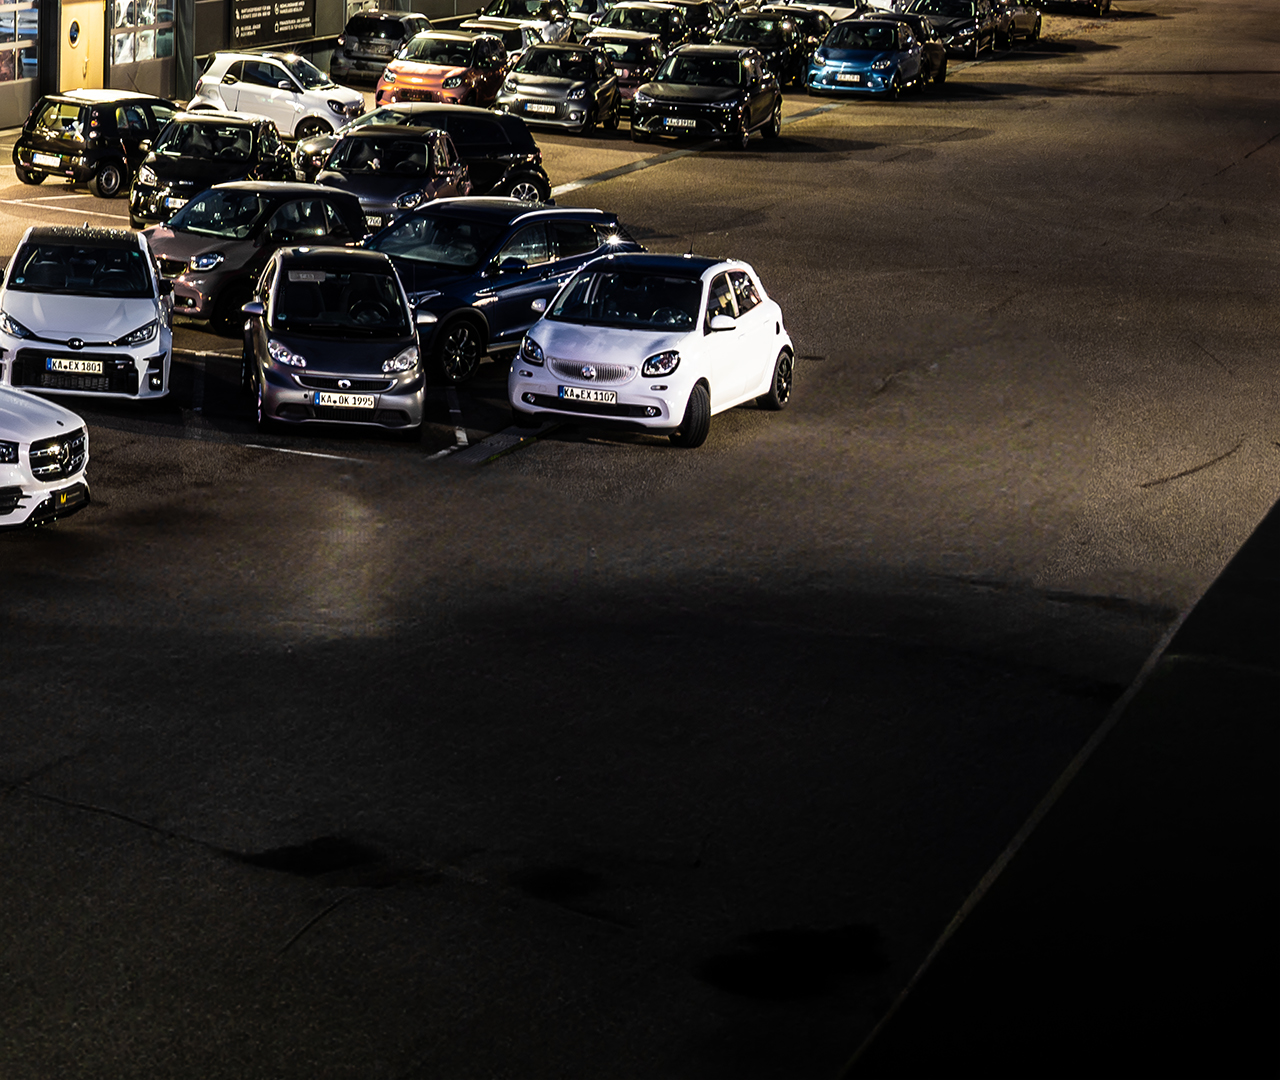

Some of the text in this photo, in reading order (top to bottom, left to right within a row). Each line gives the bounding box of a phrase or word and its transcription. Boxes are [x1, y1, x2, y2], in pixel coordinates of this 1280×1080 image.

[82, 362, 102, 372] 1801
[352, 395, 374, 407] 1995
[594, 391, 615, 402] 1107
